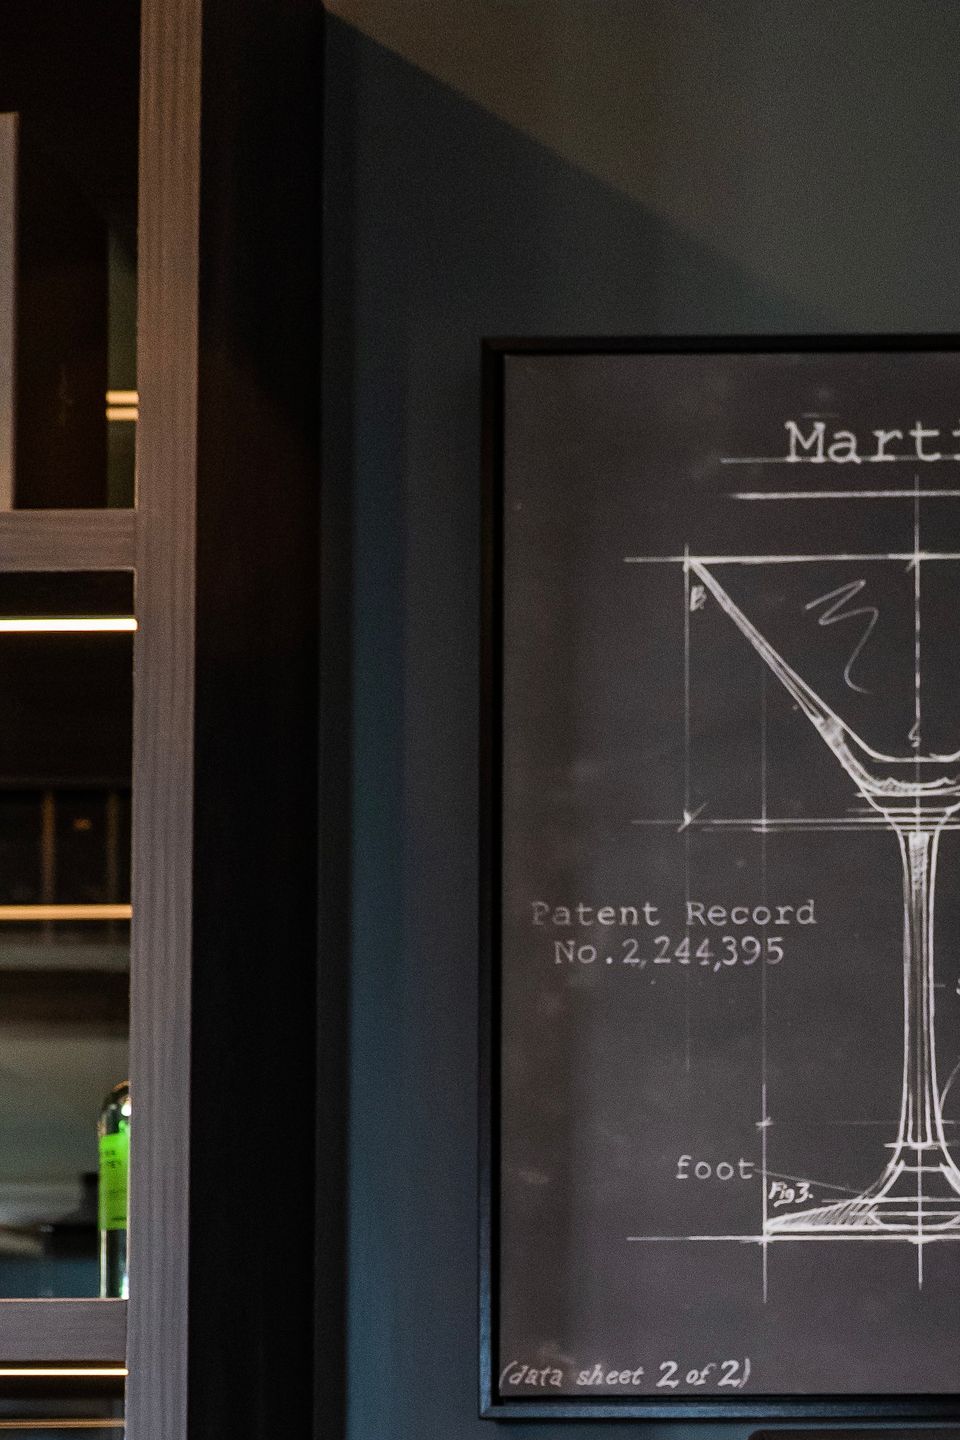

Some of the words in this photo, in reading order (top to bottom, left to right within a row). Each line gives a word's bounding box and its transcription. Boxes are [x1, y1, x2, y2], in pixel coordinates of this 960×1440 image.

[530, 901, 661, 927] Patent
[685, 899, 817, 926] Record
[676, 1154, 755, 1180] foot
[499, 1360, 564, 1388] (data
[575, 1363, 645, 1387] sheet
[655, 1360, 680, 1389] 2
[685, 1362, 717, 1387] of
[717, 1358, 751, 1389] 2)
